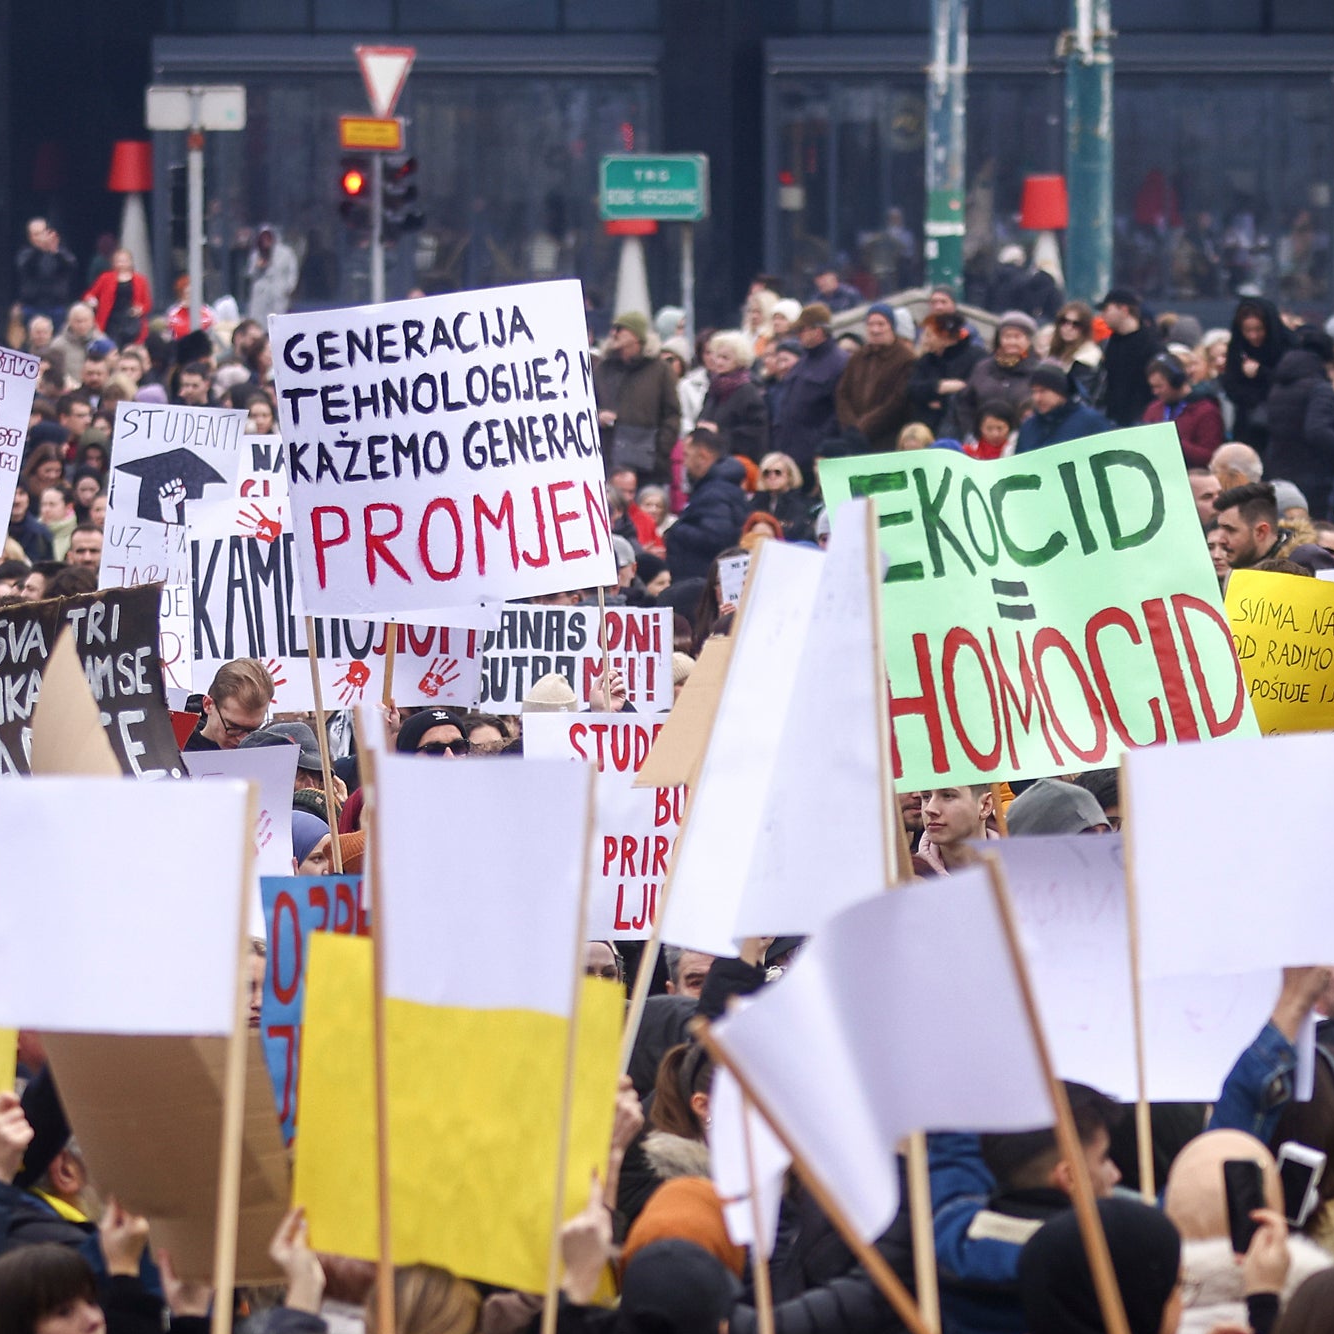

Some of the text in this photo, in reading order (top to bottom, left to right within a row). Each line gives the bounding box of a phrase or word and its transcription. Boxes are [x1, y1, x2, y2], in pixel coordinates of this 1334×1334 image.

[283, 306, 534, 374] GENERACIJA
[282, 348, 570, 425] TEHNOLOGIJE?
[121, 408, 241, 451] STUDENTI
[289, 430, 451, 485] KAŽEMO
[110, 526, 142, 548] UZ
[849, 450, 1165, 582] EKOCID
[66, 600, 120, 645] TRI
[1233, 599, 1298, 631] SVIMA
[888, 593, 1245, 779] HOMOCID
[1250, 674, 1310, 702] POŠTUJE
[602, 836, 678, 877] PRIR
